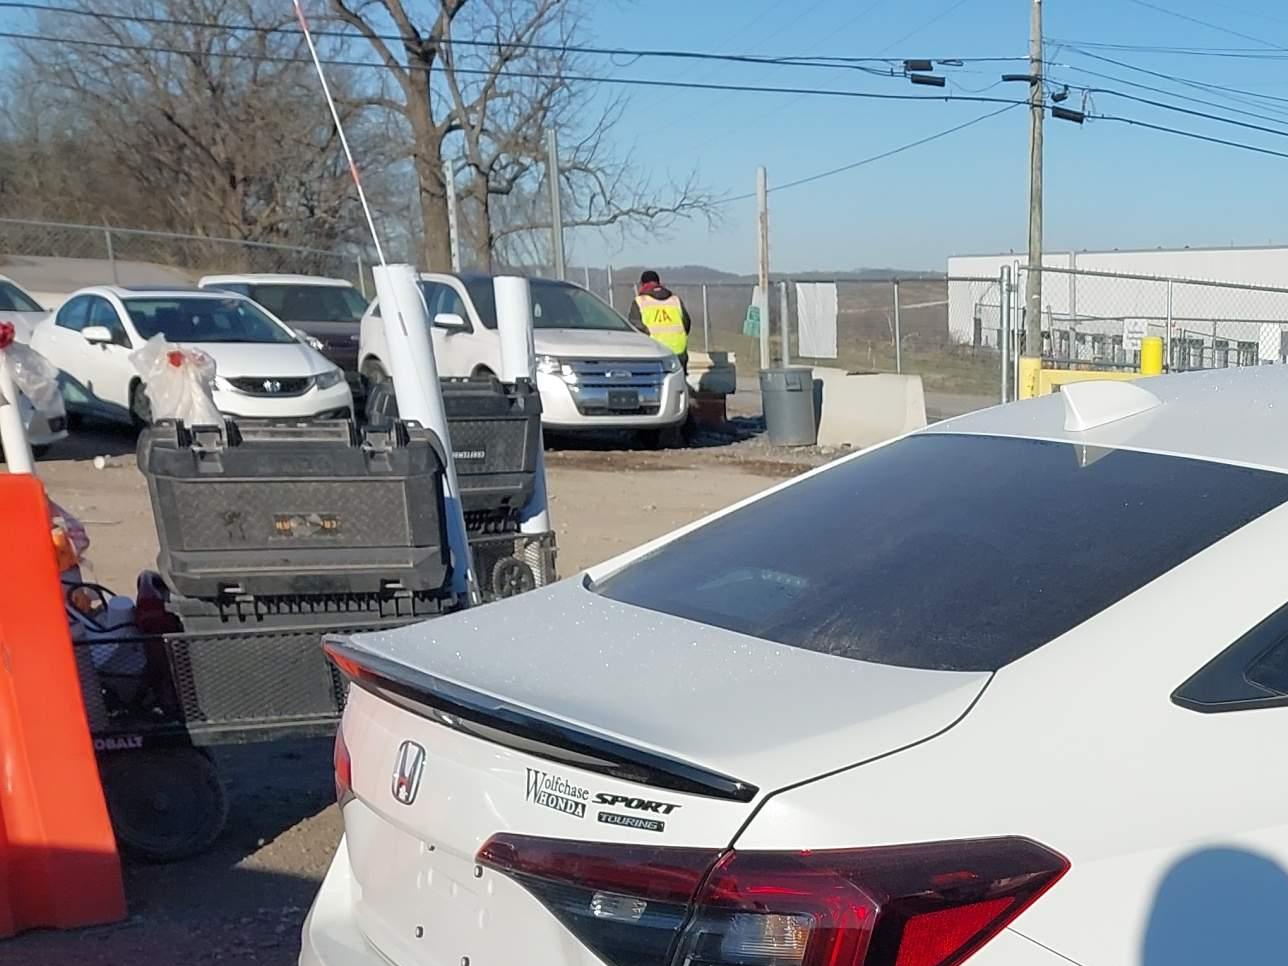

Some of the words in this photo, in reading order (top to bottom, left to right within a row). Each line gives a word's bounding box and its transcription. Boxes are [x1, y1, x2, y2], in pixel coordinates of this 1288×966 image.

[94, 735, 144, 751] OBALT
[525, 767, 590, 804] Wolfchase
[538, 791, 585, 817] HONDA
[591, 792, 683, 815] SPORT
[599, 813, 659, 830] TOURING
